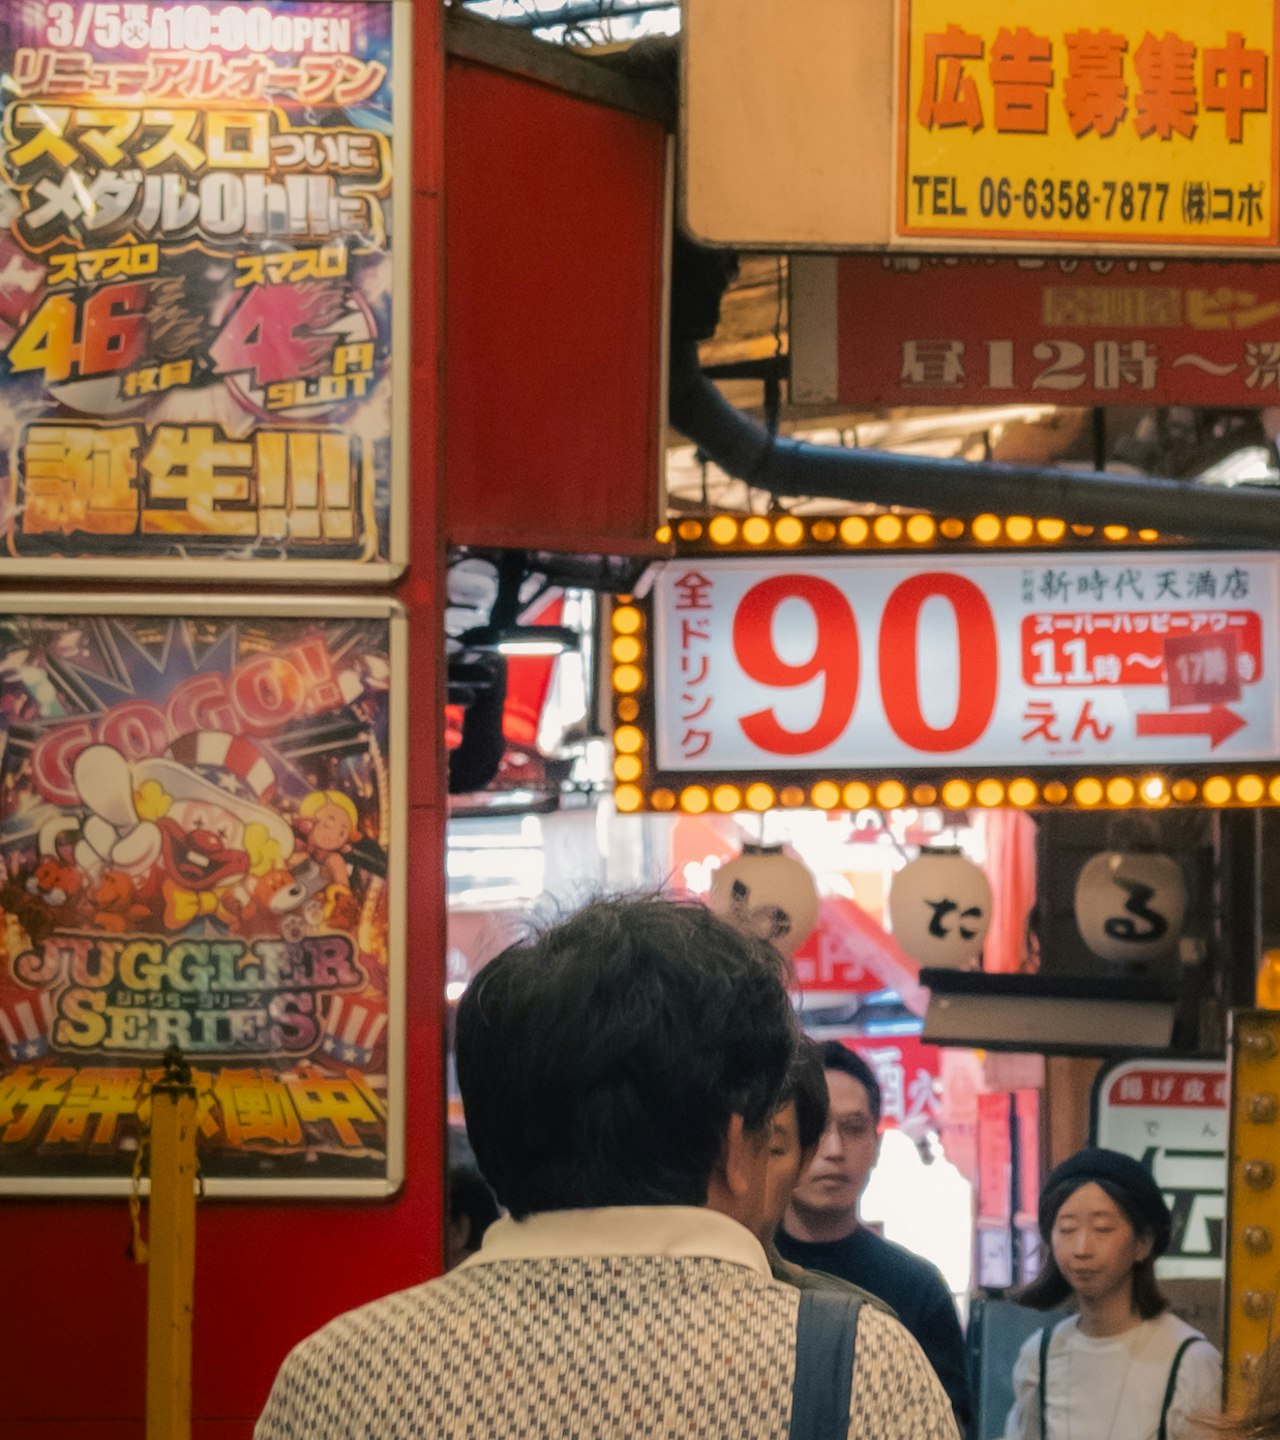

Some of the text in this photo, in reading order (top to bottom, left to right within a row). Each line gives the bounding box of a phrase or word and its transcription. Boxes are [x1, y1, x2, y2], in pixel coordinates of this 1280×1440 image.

[13, 48, 387, 105] リニューアルオープン
[916, 24, 1269, 145] 広告募集中
[911, 175, 967, 219] TEL
[978, 176, 1171, 226] 06-6358-7877
[48, 243, 159, 287] スマスロ
[234, 244, 349, 289] スマスロ
[23, 424, 358, 543] 誕生!!!
[1040, 568, 1145, 605] 新時代
[1154, 567, 1249, 601] 天満店
[673, 570, 715, 761] 全ドリンク
[731, 570, 1001, 757] 90
[1020, 699, 1116, 745] えん
[1102, 876, 1169, 941] る
[14, 936, 366, 992] JUGGLER
[58, 990, 319, 1051] SERIES
